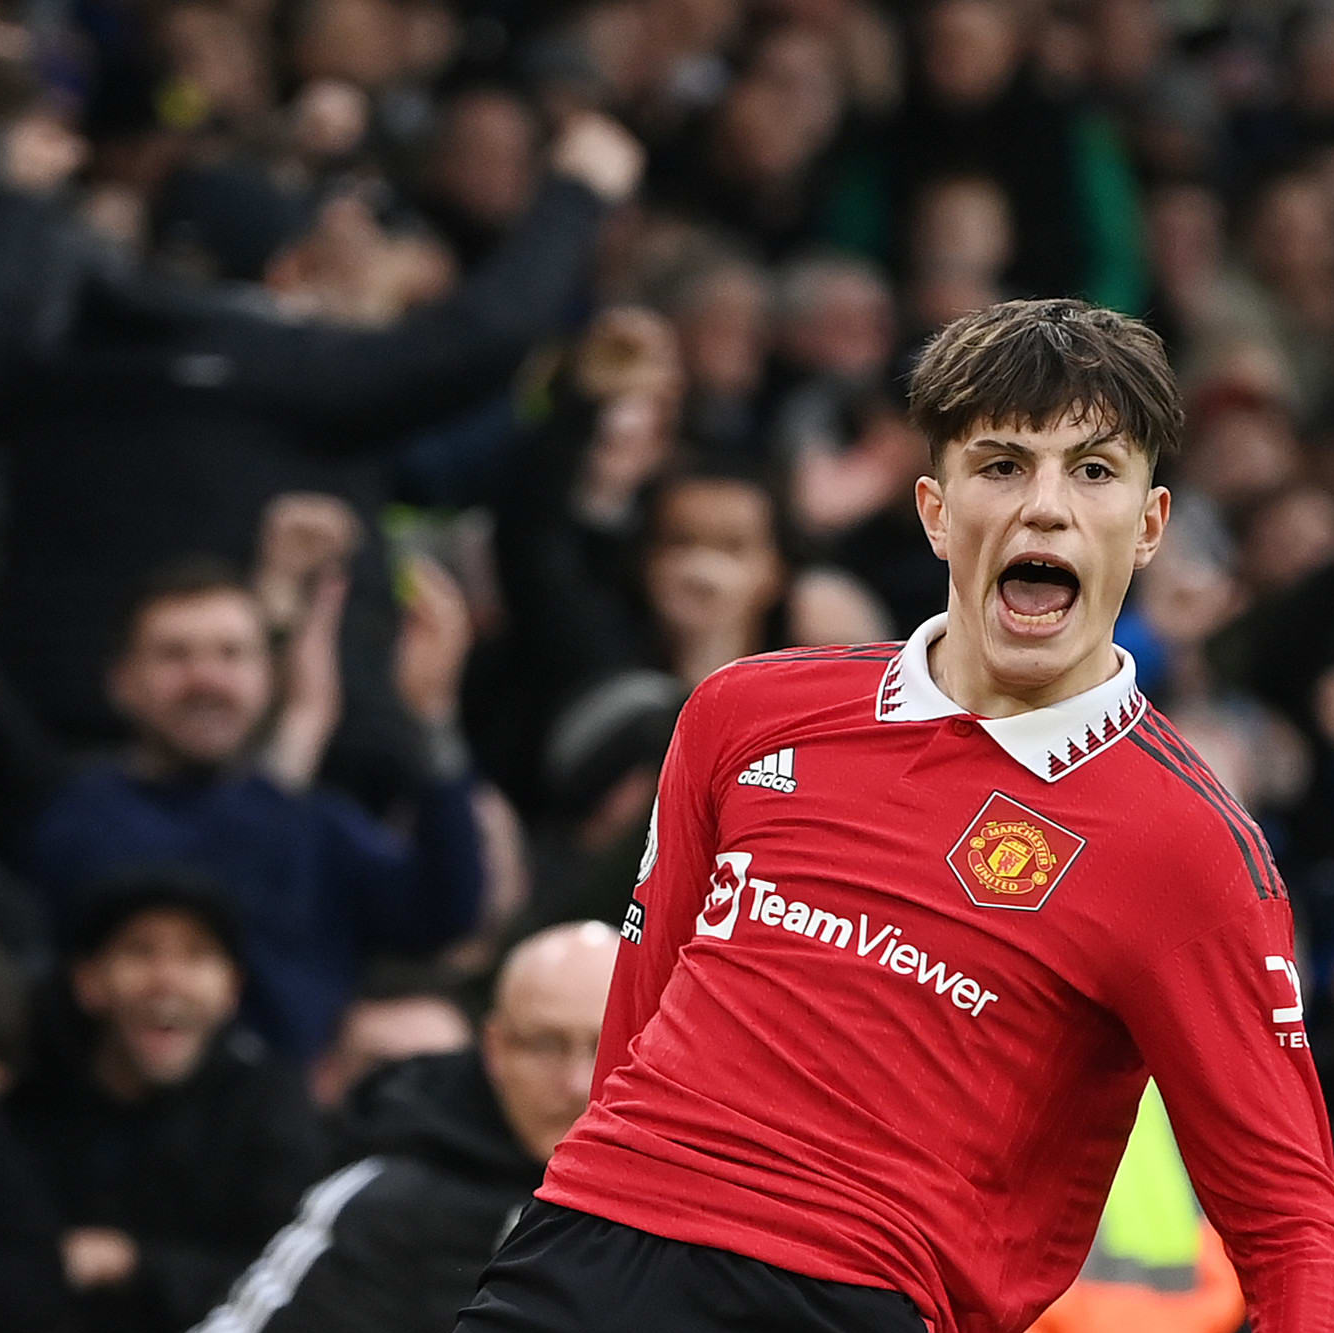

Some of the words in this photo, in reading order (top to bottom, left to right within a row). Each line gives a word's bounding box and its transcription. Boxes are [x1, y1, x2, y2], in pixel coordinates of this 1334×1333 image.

[737, 769, 798, 793] adidas
[988, 825, 1049, 865] MANCHESTER
[974, 863, 1018, 891] UNITED
[748, 878, 999, 1018] TeamViewer
[1275, 1031, 1310, 1049] TE
